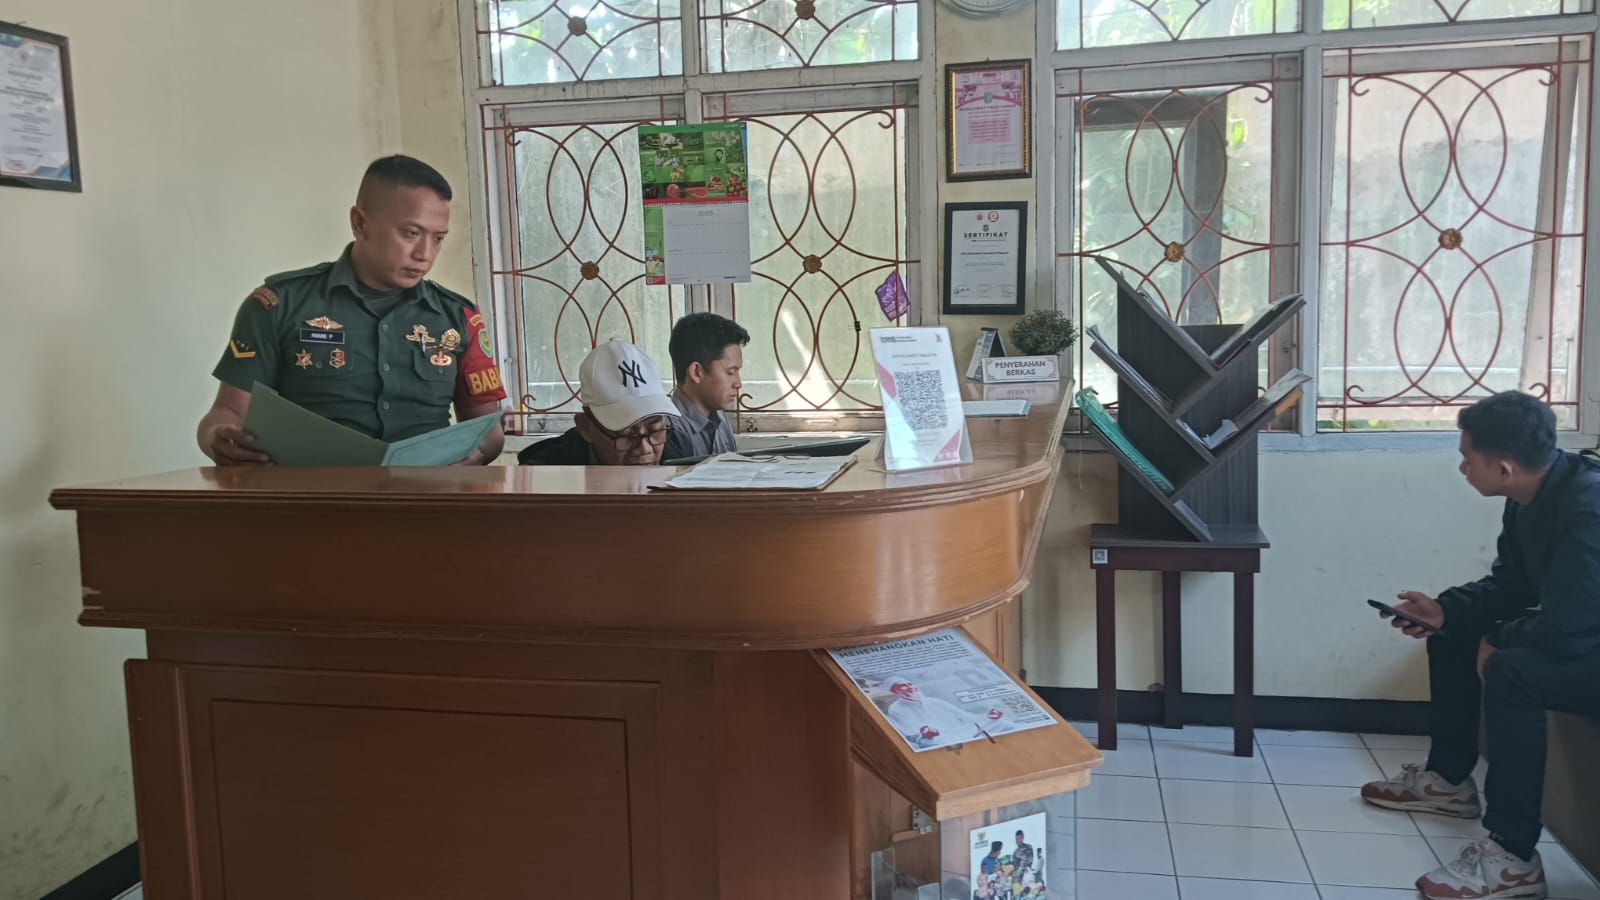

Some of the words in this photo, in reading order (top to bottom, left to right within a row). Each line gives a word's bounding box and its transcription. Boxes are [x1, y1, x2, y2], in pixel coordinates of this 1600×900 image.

[963, 231, 1008, 239] SERTIFIKAT
[995, 360, 1046, 369] PENYERAHAN
[618, 360, 647, 387] NY
[1006, 368, 1037, 376] BERKAS
[839, 639, 926, 659] MENENANGKAN
[927, 634, 955, 644] HATI
